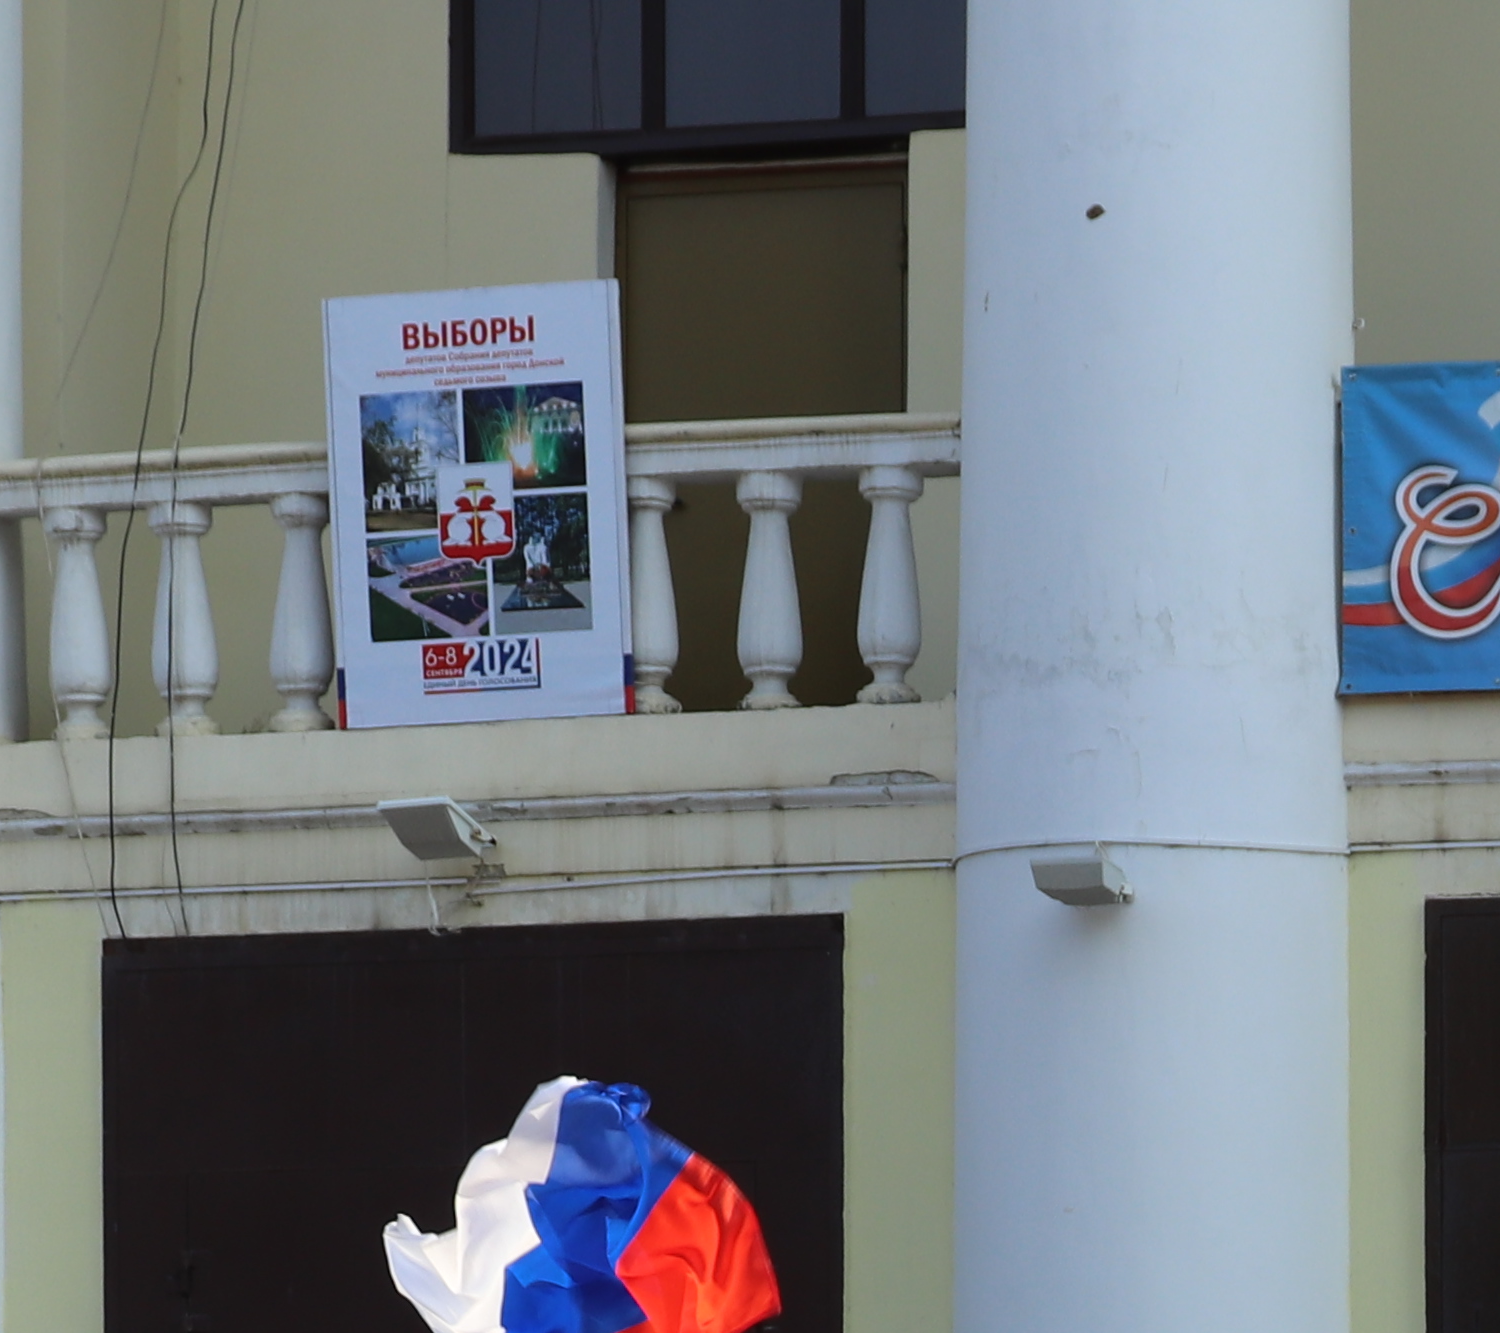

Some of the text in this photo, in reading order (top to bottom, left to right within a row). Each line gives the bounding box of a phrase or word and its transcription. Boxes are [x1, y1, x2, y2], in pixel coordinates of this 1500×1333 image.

[402, 315, 535, 350] ВЫБОРЫ
[425, 638, 535, 677] 6-8 2024
[426, 668, 463, 678] СЕНТЯБРЯ
